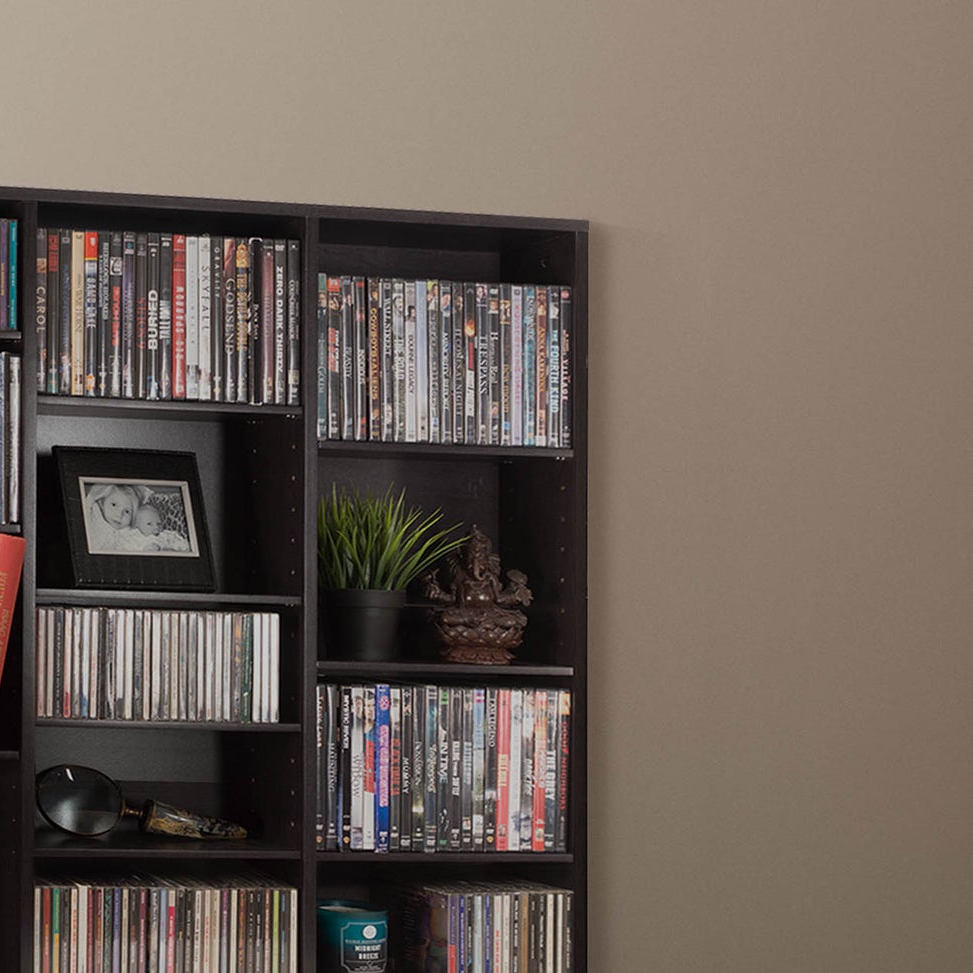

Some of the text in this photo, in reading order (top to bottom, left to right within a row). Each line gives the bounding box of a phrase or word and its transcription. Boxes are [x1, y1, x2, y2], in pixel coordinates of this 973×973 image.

[201, 265, 210, 332] SKYFALL
[276, 266, 284, 297] ZERO
[36, 286, 46, 334] CAROL
[148, 289, 159, 351] BURIED
[225, 278, 236, 355] GODSEND
[276, 299, 284, 330] DARK
[370, 307, 379, 356] COWBOYS
[384, 297, 393, 356] WALL STREET
[538, 326, 547, 350] ANNA
[370, 364, 379, 400] ALIENS
[479, 335, 488, 395] TRESPASS
[550, 344, 559, 384] FOURTH
[454, 383, 463, 417] NIGHT
[402, 756, 410, 794] MUMMY
[438, 755, 449, 785] TIME
[545, 749, 557, 801] THE GREY
